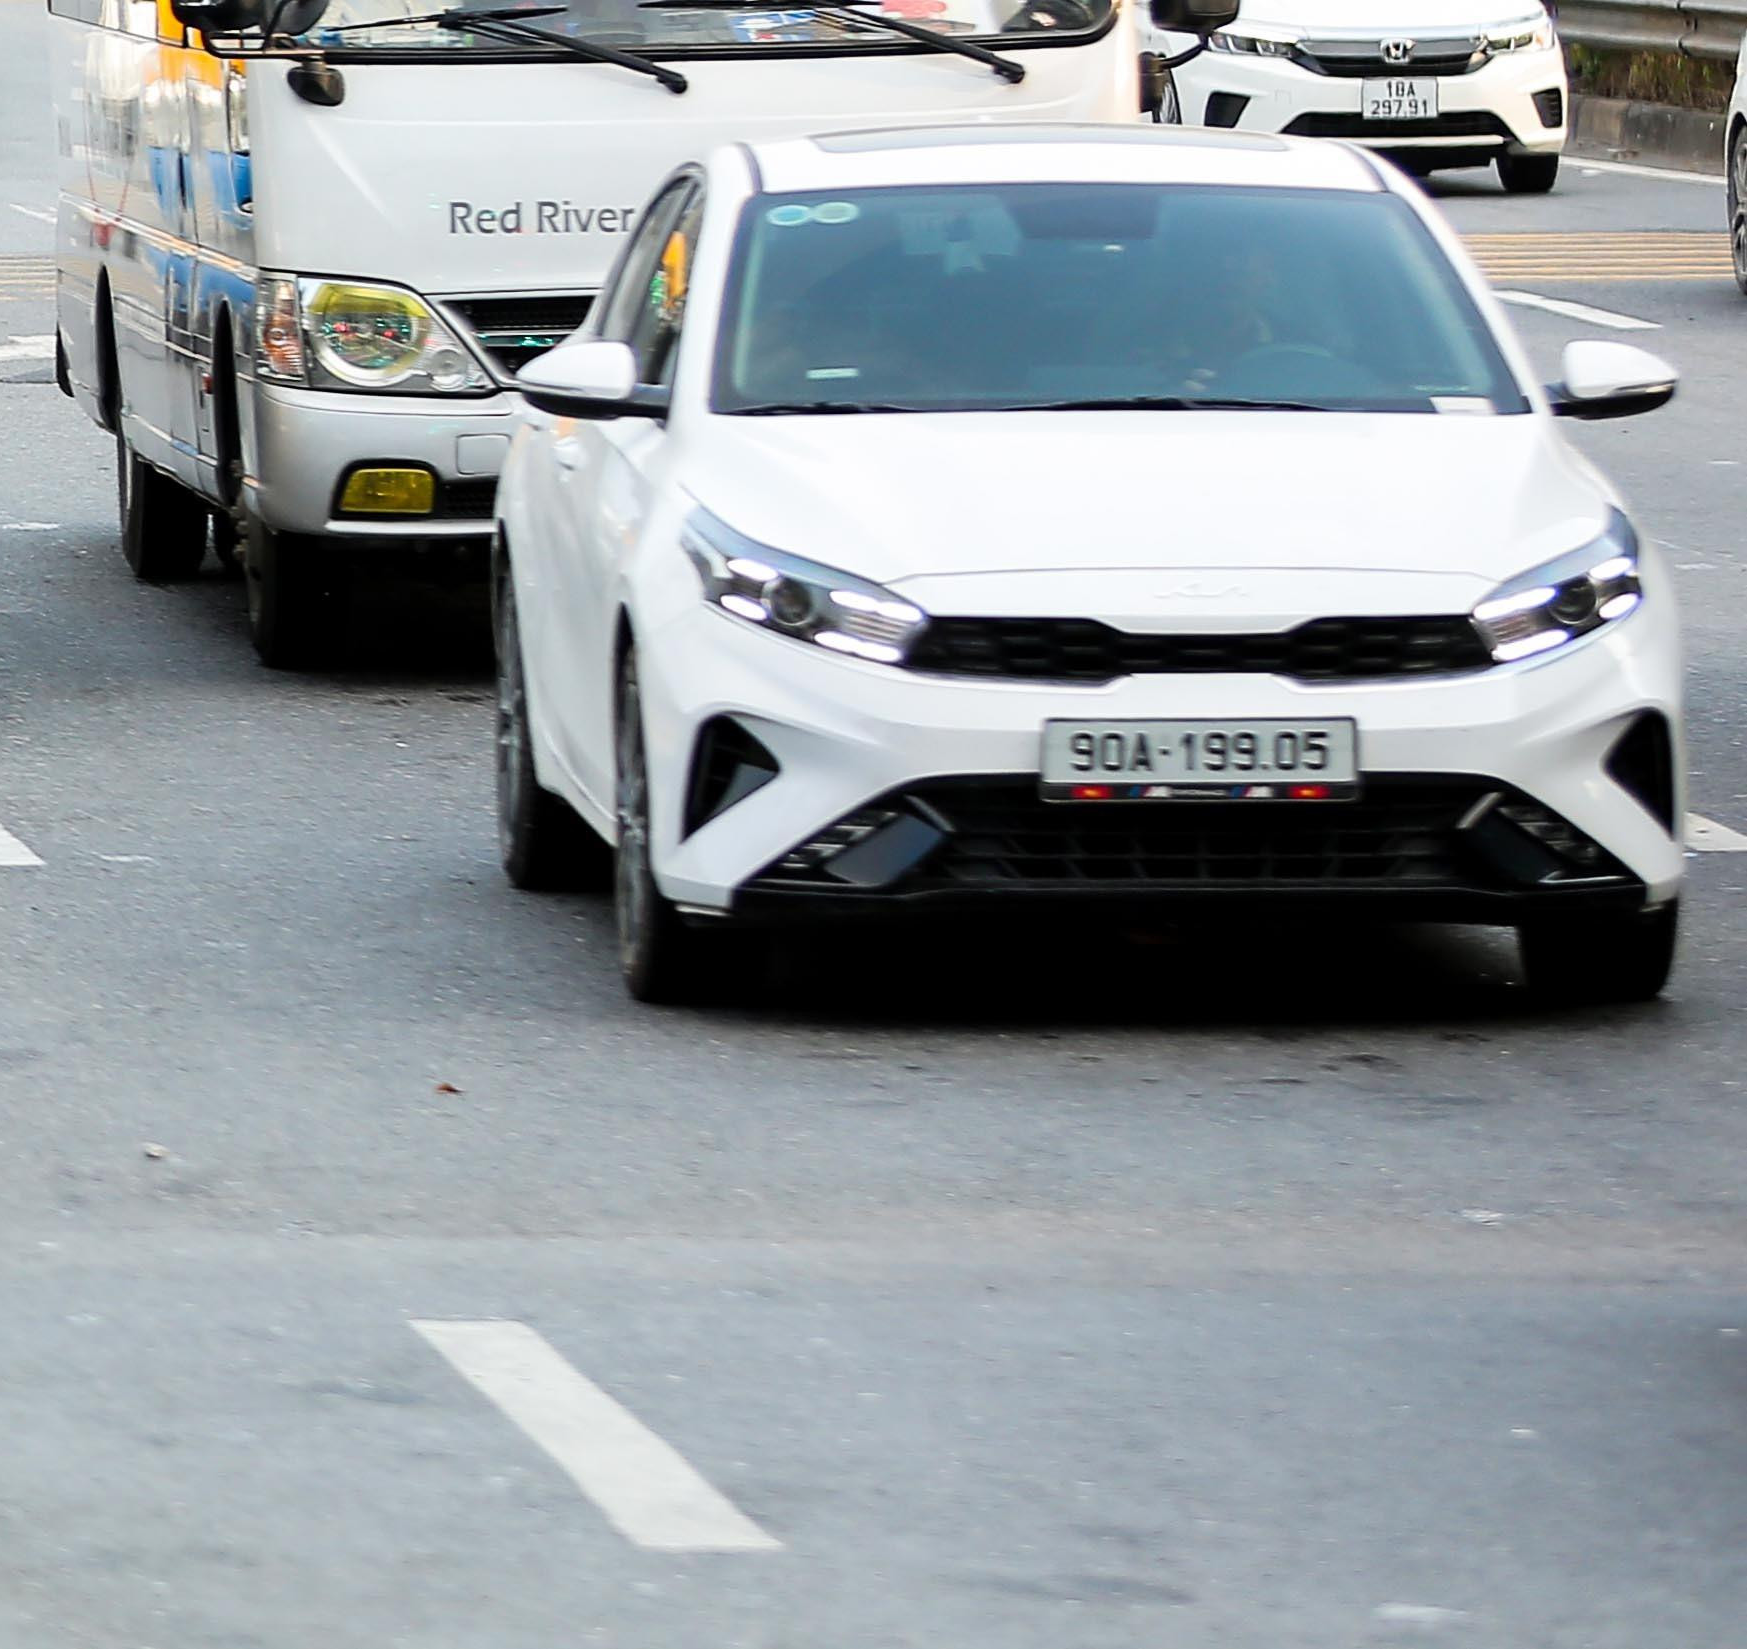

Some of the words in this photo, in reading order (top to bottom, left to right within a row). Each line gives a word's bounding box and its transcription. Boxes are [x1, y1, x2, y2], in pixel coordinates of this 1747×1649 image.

[449, 201, 523, 234] Red
[535, 200, 635, 233] River
[1069, 730, 1330, 772] 90A-199.05
